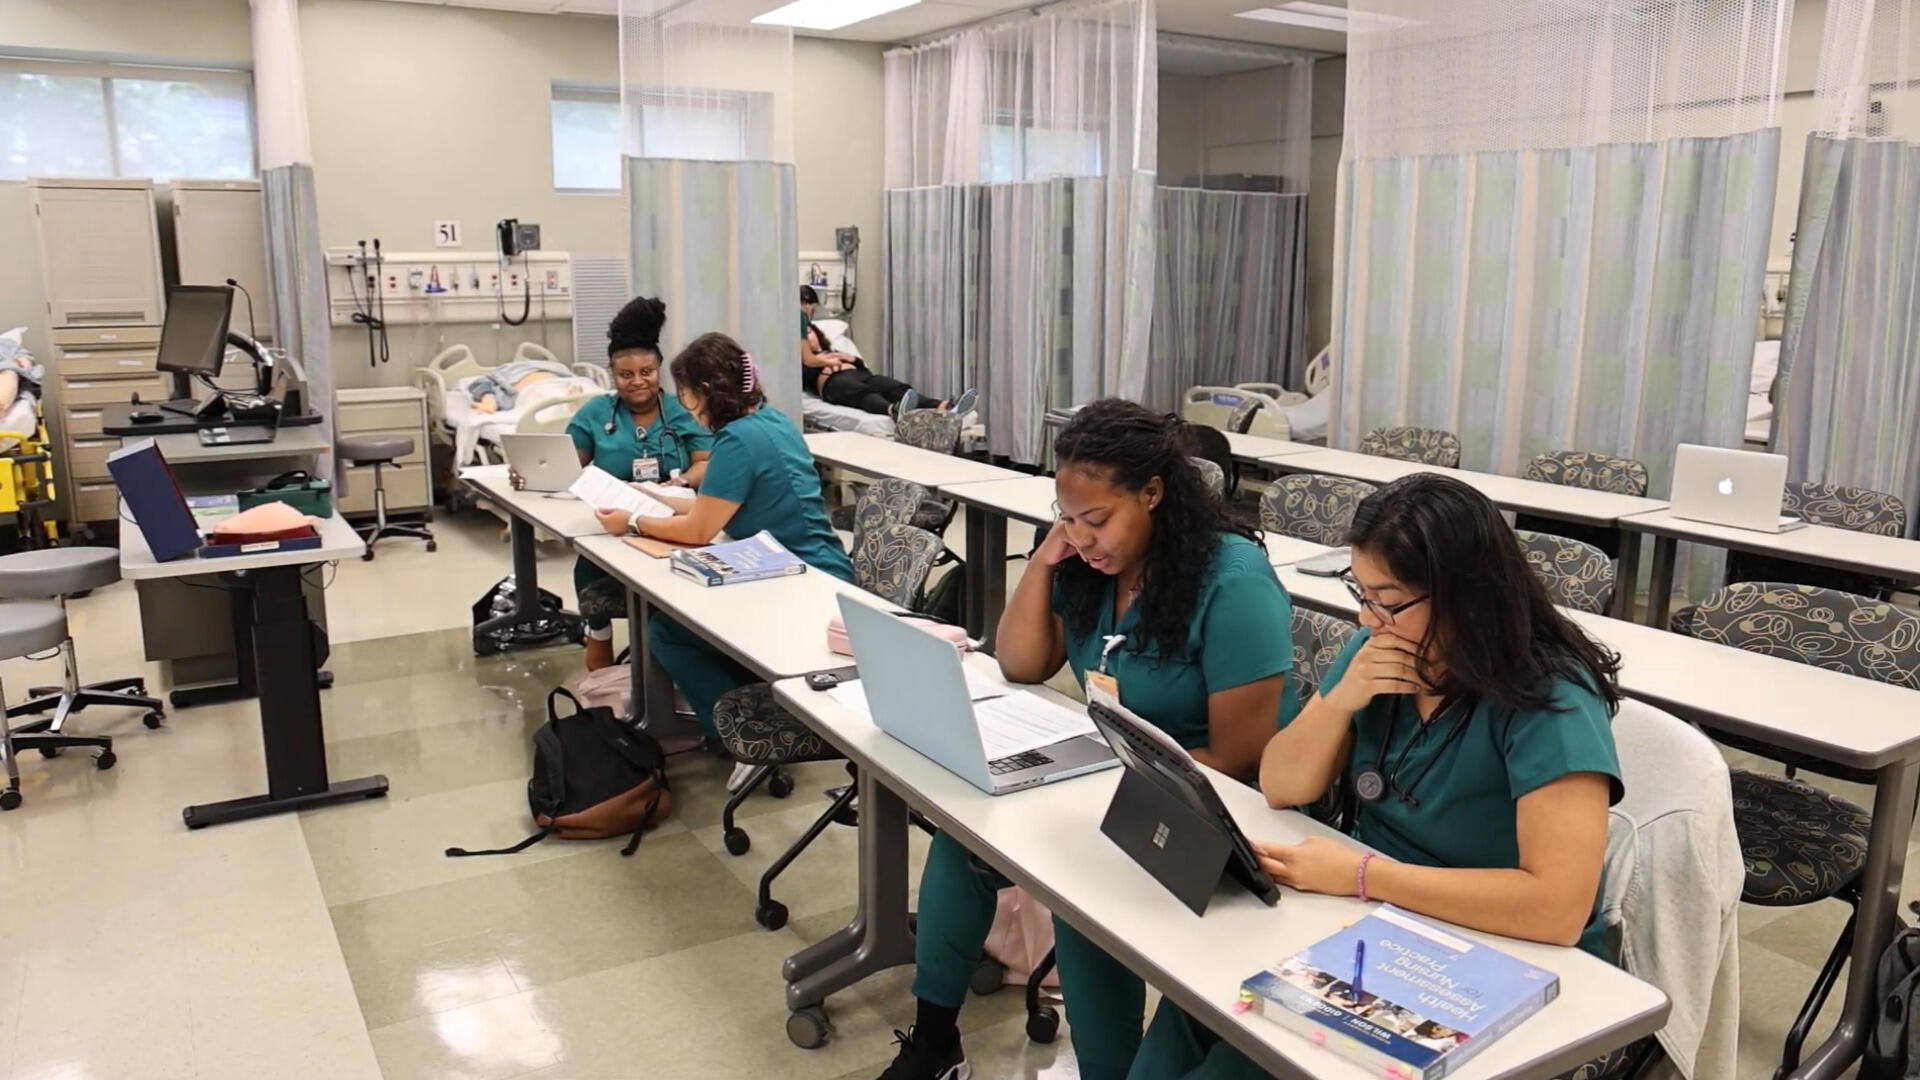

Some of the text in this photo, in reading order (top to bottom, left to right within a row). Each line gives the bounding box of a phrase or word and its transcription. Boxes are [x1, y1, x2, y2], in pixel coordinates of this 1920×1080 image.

[439, 223, 456, 244] 51
[1379, 939, 1448, 972] Practice
[1376, 962, 1487, 1012] Assessment
[1394, 955, 1485, 999] for Nursing
[1417, 992, 1479, 1021] Health
[1350, 1018, 1391, 1039] WILSON
